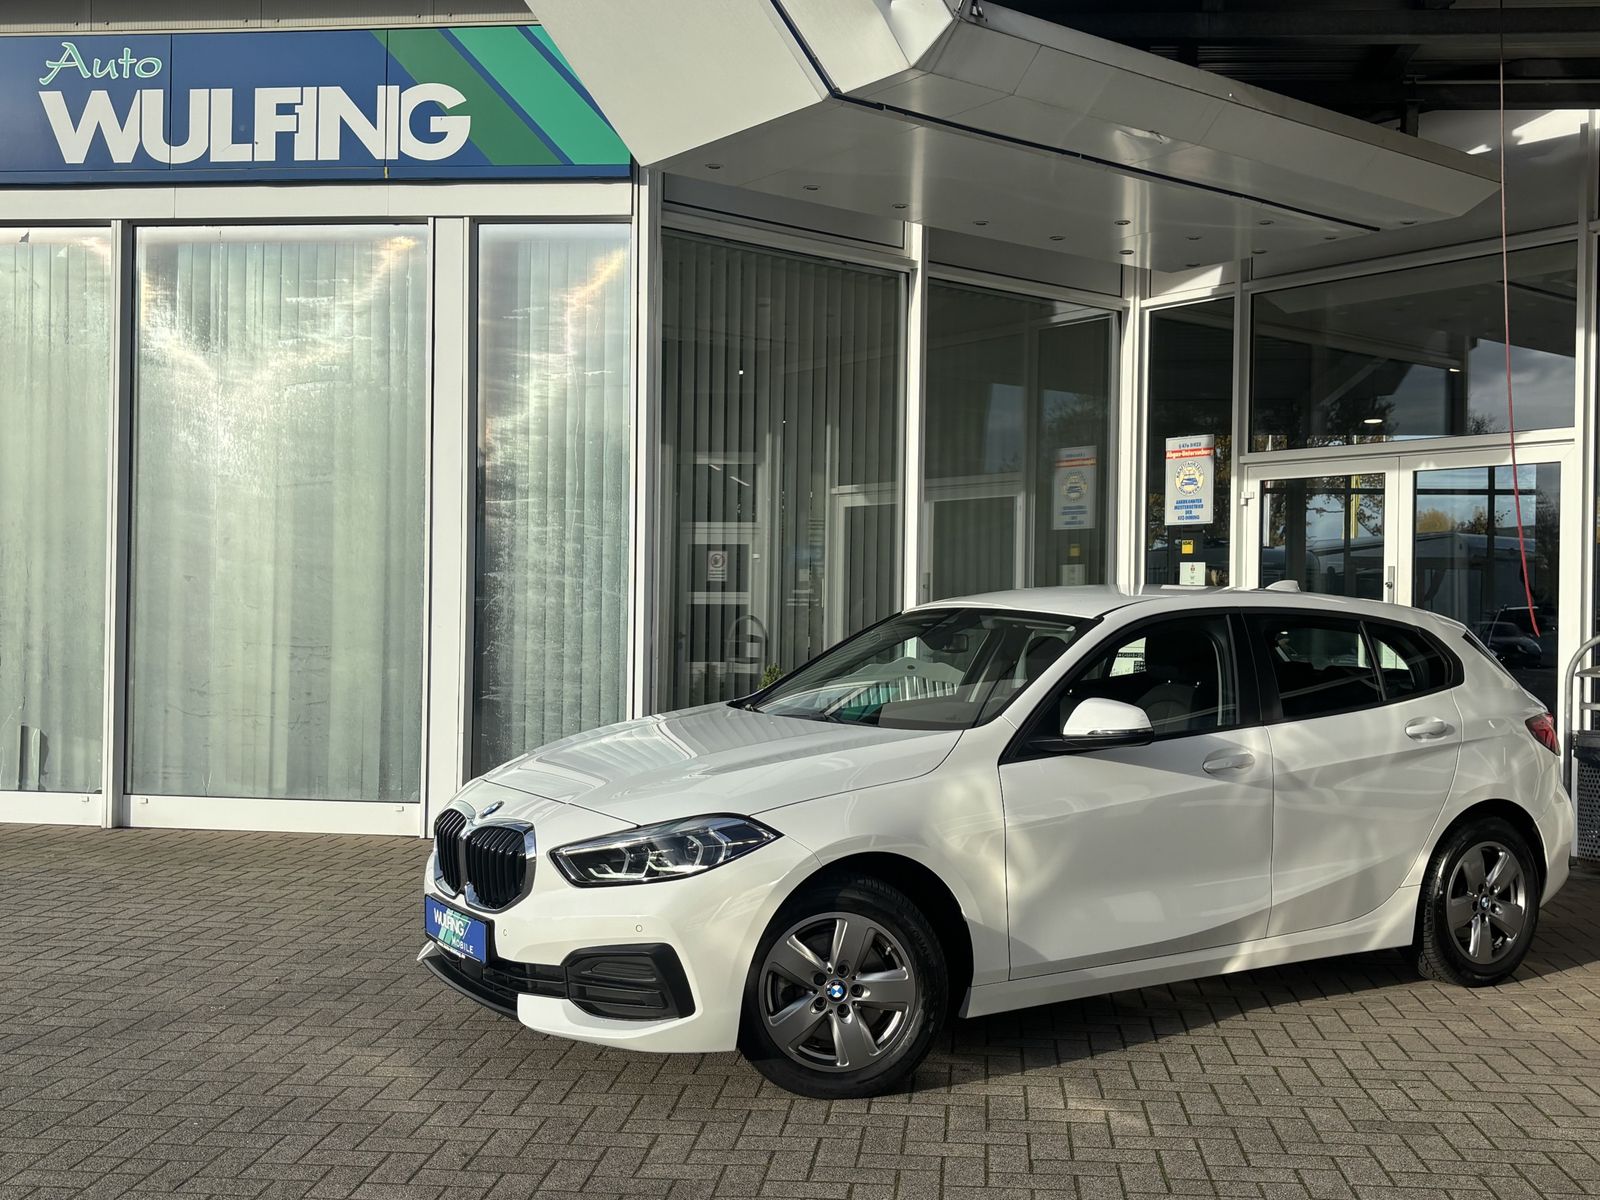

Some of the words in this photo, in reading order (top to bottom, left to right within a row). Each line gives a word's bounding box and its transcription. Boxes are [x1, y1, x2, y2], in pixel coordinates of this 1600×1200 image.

[39, 41, 163, 87] Auto
[38, 82, 472, 165] WULFING
[451, 936, 474, 955] MOBILE
